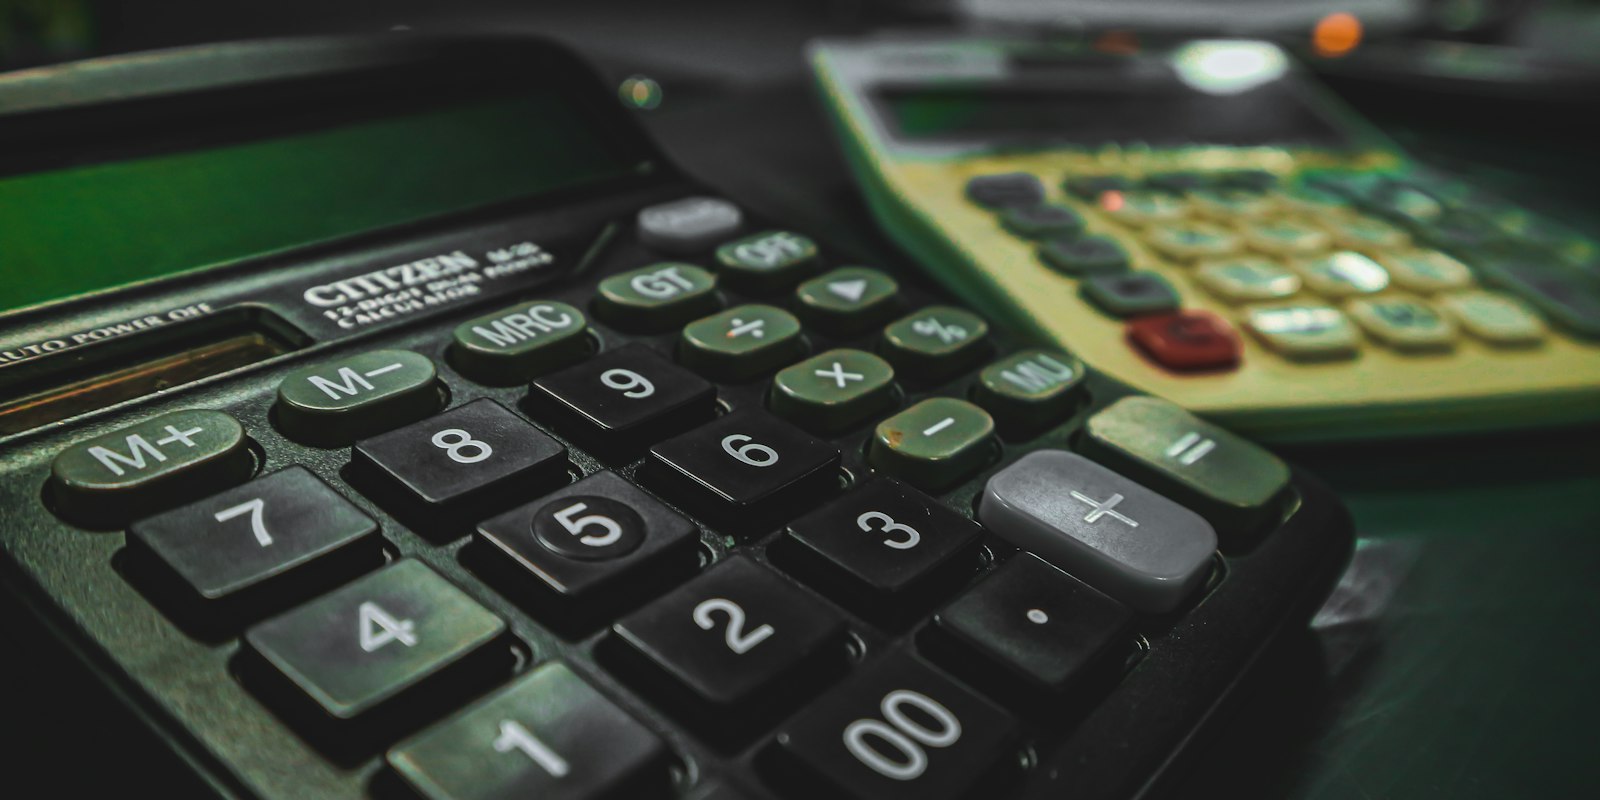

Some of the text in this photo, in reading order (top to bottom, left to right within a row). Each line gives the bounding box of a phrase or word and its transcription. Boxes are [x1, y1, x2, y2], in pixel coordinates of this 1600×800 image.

[303, 250, 479, 308] CITIZEN
[631, 267, 693, 297] GT
[71, 315, 162, 345] POWER
[168, 302, 215, 321] OFF
[472, 305, 573, 348] MRC
[600, 368, 655, 399] 9
[1001, 354, 1073, 394] MU
[87, 424, 203, 477] M+
[431, 428, 493, 464] 8
[721, 434, 779, 467] 6
[214, 498, 273, 547] 7
[552, 502, 623, 547] 5
[856, 511, 921, 550] 3
[358, 601, 418, 653] 4
[693, 598, 774, 654] 2
[492, 719, 570, 778] 1
[844, 690, 960, 778] 00
